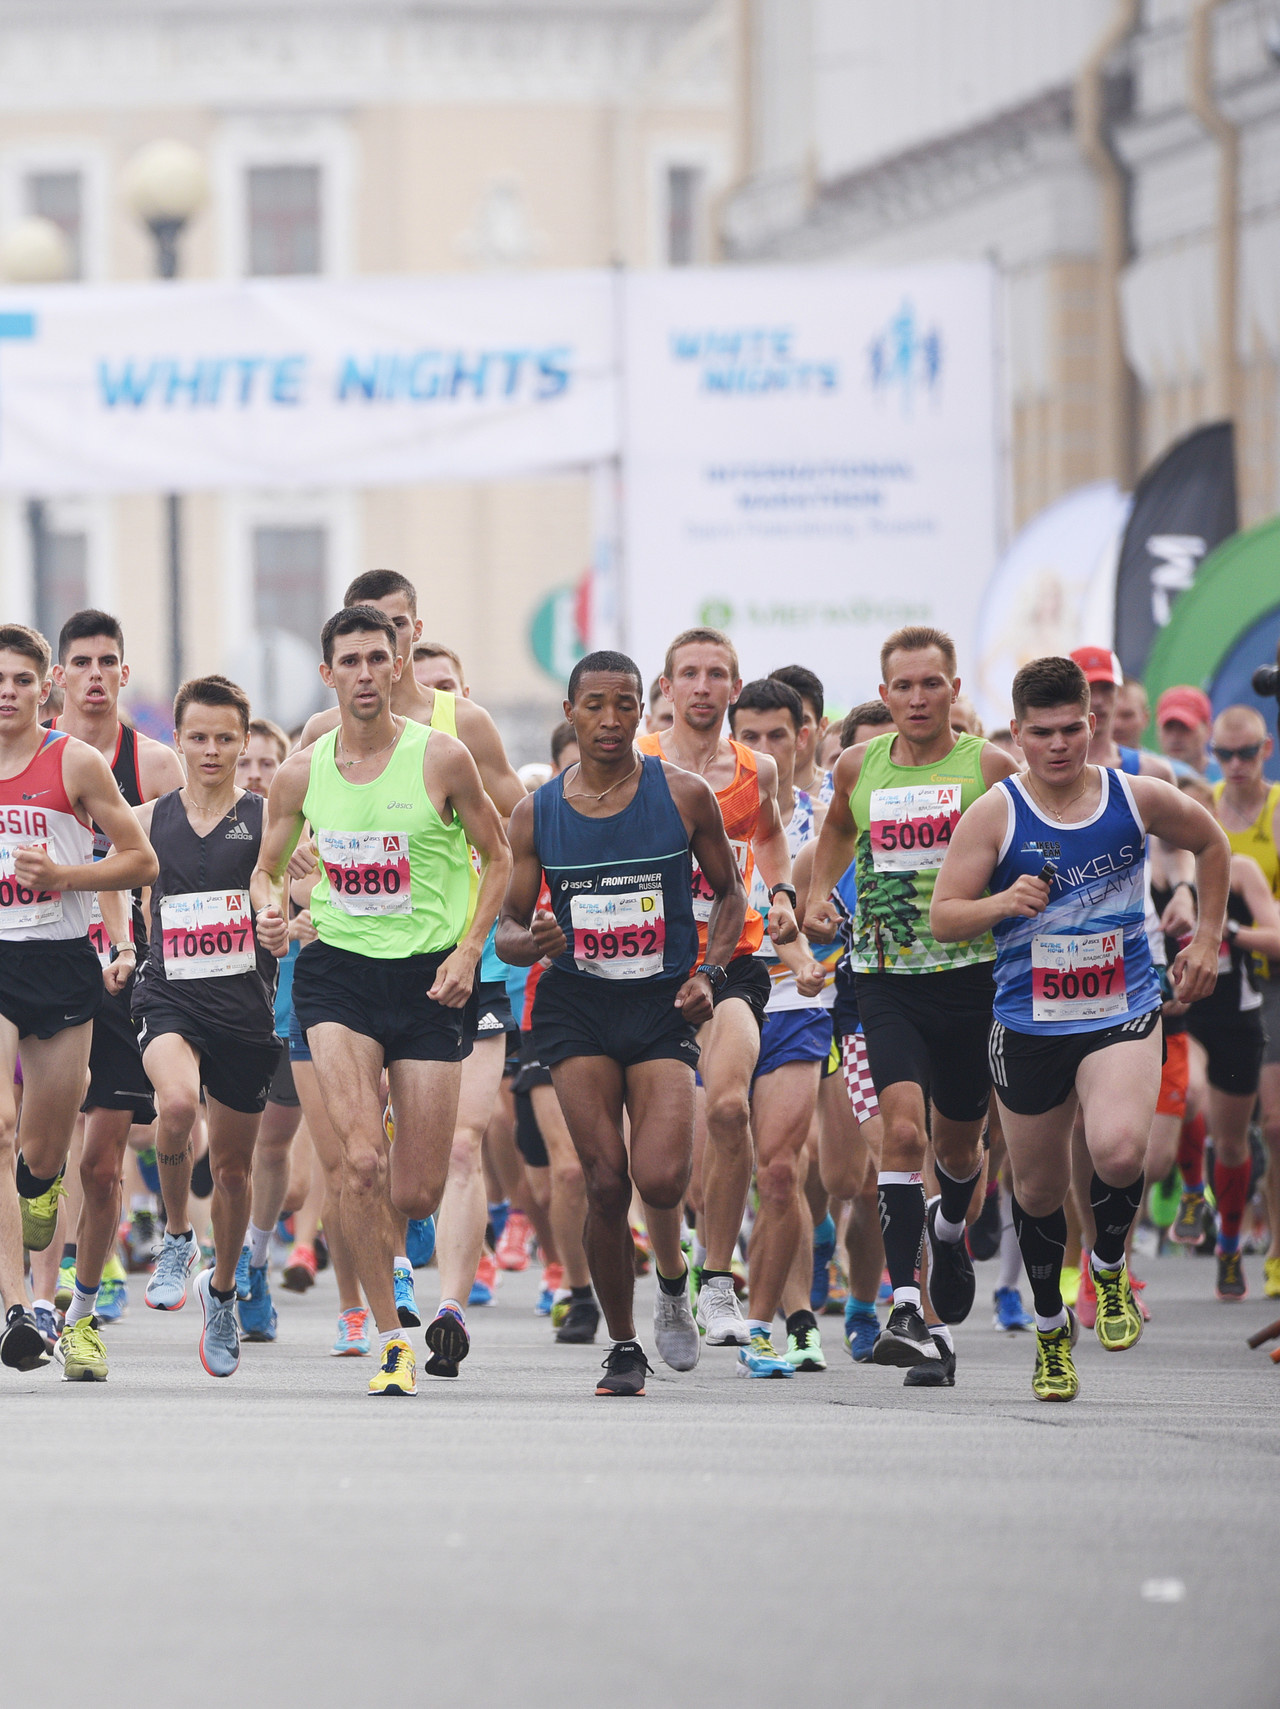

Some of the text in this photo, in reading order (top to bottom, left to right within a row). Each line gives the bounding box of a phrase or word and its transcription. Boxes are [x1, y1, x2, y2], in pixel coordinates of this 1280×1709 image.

[97, 345, 574, 412] WHITE NIGHTS
[395, 801, 414, 809] asics
[225, 832, 253, 841] adidas
[881, 820, 953, 851] 5004
[570, 872, 662, 889] asics FRONTRUNNER
[1055, 845, 1134, 891] NIKELS
[638, 882, 663, 891] RUSSIA
[1071, 869, 1134, 909] TEAM
[168, 928, 248, 958] 10607
[583, 929, 657, 960] 9952
[1042, 968, 1116, 1000] 5007
[478, 1022, 504, 1031] adidas
